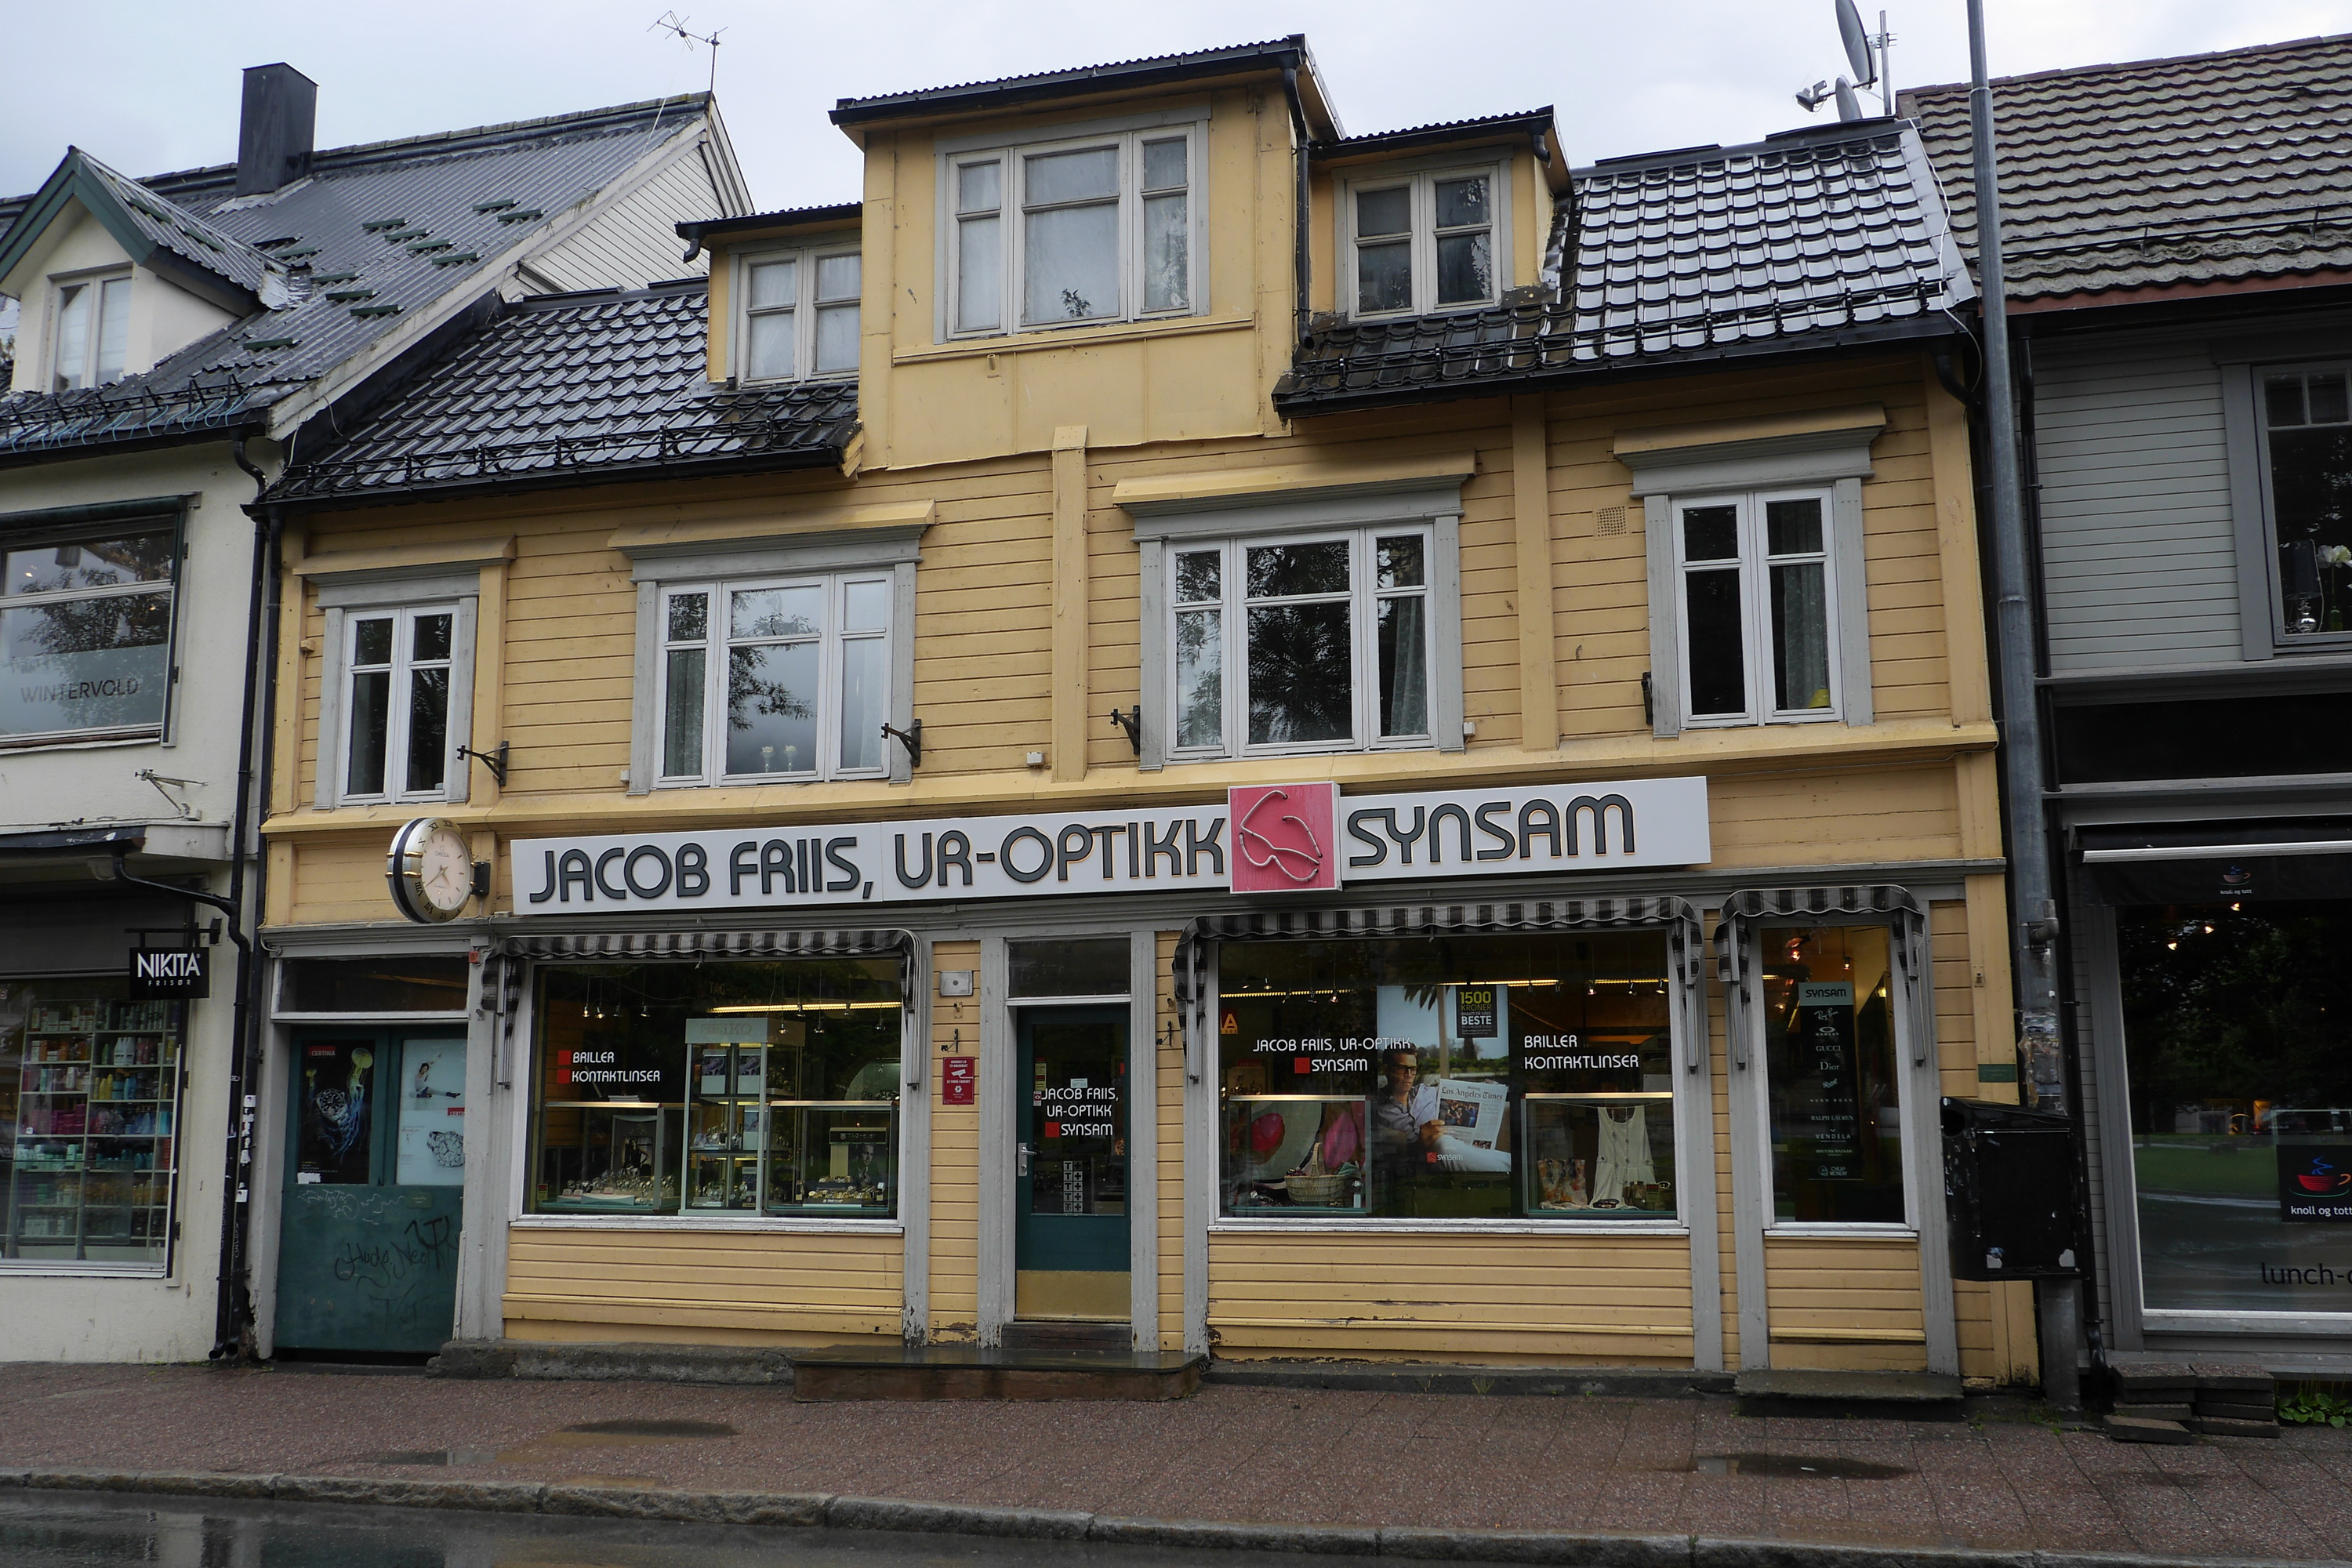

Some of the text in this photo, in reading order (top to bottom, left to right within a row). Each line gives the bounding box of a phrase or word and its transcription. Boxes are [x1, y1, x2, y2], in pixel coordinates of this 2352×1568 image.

[21, 678, 140, 702] WINTERVOLD
[529, 793, 1636, 903] JACOB FRIIS, UR-OPTIKK SYNSAM
[137, 952, 201, 978] NIKITA
[1460, 991, 1491, 1004] 1500
[1806, 989, 1847, 998] SYNSAM
[1461, 1016, 1492, 1025] BESTE
[700, 1022, 752, 1036] SEIKO
[1253, 1036, 1411, 1052] JACOB FRIIS, UR-OPTIKK
[1524, 1034, 1577, 1048] BRILLER
[572, 1051, 615, 1064] BRILLER
[1524, 1054, 1639, 1069] KONTAKTLINSER
[1312, 1058, 1368, 1072] SYNSAM
[1820, 1062, 1840, 1071] Dior
[572, 1069, 661, 1083] KONTAKTLINSER
[1041, 1088, 1083, 1100] JACOB
[1087, 1087, 1119, 1102] FRIIS,
[1455, 1089, 1482, 1098] Angeles
[1483, 1091, 1504, 1101] Times
[1047, 1105, 1112, 1117] UR-OPTIKK
[1061, 1123, 1113, 1136] SYNSAM
[2290, 1206, 2315, 1215] knoll
[2318, 1207, 2332, 1218] og
[2261, 1262, 2352, 1286] lunch-
